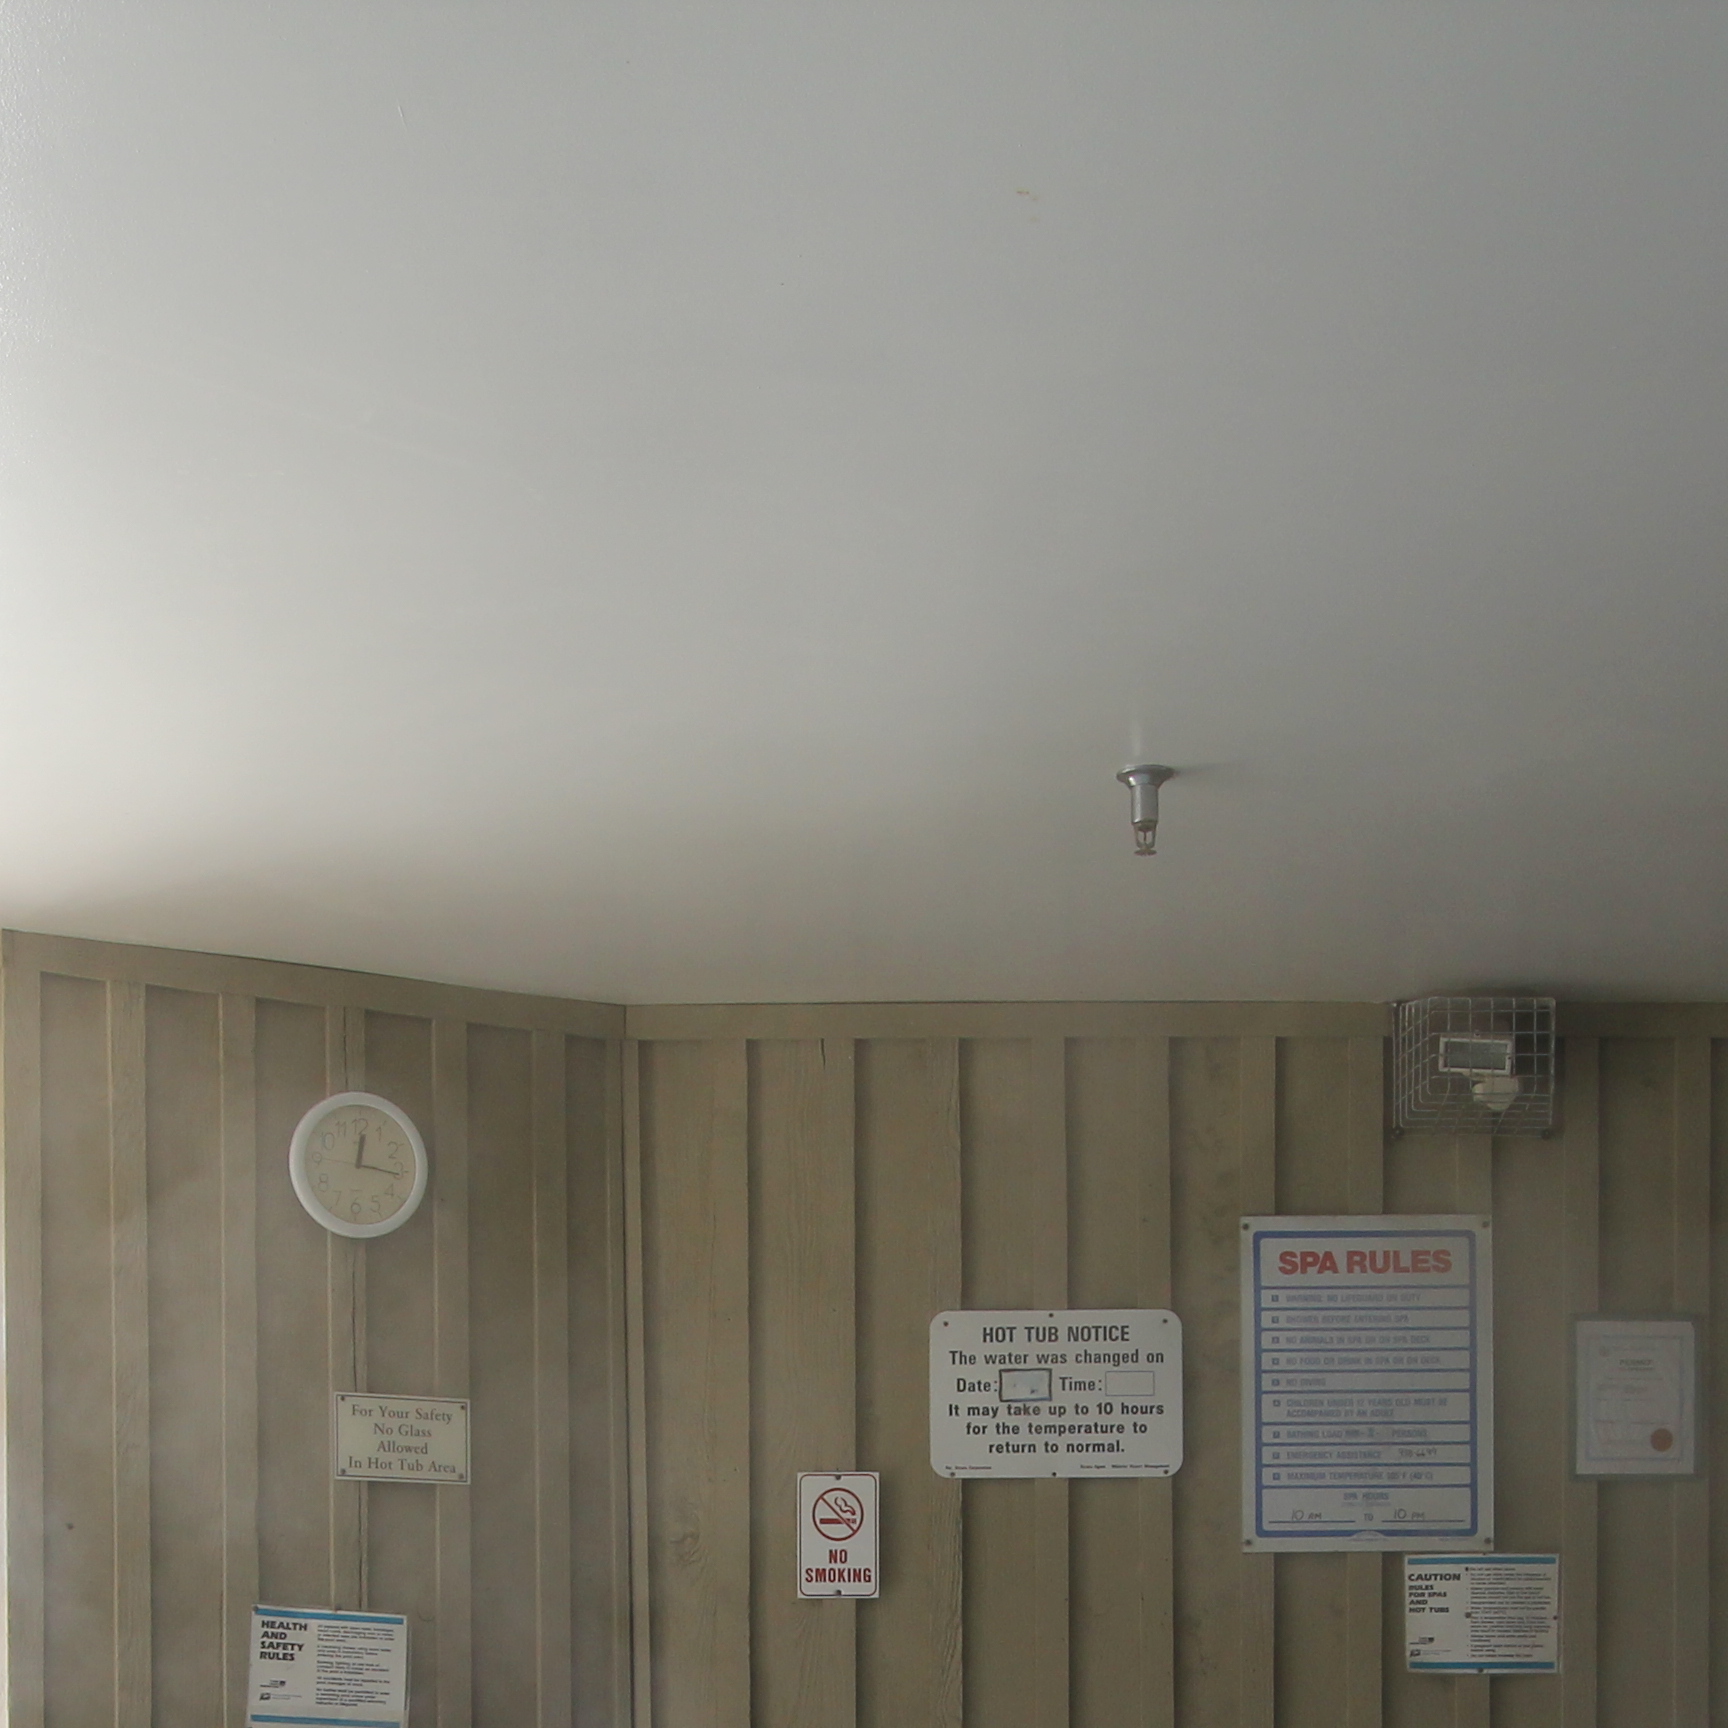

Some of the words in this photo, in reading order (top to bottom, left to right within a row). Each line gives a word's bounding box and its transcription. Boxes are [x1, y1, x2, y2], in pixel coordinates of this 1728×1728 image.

[335, 1120, 347, 1138] 11
[352, 1118, 368, 1135] 12
[375, 1126, 382, 1141] 1
[388, 1142, 398, 1159] 2
[312, 1152, 322, 1166] 9
[393, 1162, 404, 1180] 3
[318, 1173, 329, 1192] 8
[333, 1191, 342, 1206] 7
[384, 1184, 394, 1198] 4
[350, 1197, 362, 1214] 6
[370, 1195, 381, 1213] 5
[1278, 1250, 1340, 1275] SPA
[1346, 1250, 1453, 1275] RULES
[982, 1326, 1016, 1343] HOT
[1024, 1326, 1059, 1342] TUB
[1068, 1325, 1130, 1342] NOTICE
[950, 1351, 976, 1365] The
[984, 1352, 1028, 1365] water
[1036, 1352, 1067, 1364] was
[1075, 1350, 1139, 1367] changed
[1146, 1352, 1164, 1364] on
[956, 1378, 998, 1393] Date:
[1060, 1376, 1102, 1392] Time:
[352, 1404, 374, 1417] For
[378, 1405, 410, 1419] Your
[415, 1408, 453, 1425] Safety
[948, 1404, 960, 1416] It
[967, 1406, 999, 1418] may
[1006, 1403, 1040, 1416] take
[1048, 1405, 1066, 1418] up
[1074, 1404, 1088, 1416] to
[1096, 1403, 1114, 1415] 10
[1120, 1402, 1164, 1415] hours
[374, 1422, 394, 1436] No
[398, 1424, 432, 1438] Glass
[966, 1422, 988, 1435] for
[996, 1422, 1020, 1435] the
[1028, 1422, 1125, 1436] temperature
[1132, 1422, 1148, 1434] to
[377, 1440, 428, 1455] Allowed
[989, 1442, 1036, 1454] return
[1044, 1441, 1058, 1454] to
[1066, 1440, 1124, 1453] normal.
[348, 1456, 362, 1468] In
[368, 1456, 392, 1470] Hot
[398, 1458, 424, 1472] Tub
[428, 1460, 456, 1474] Area
[1292, 1510, 1304, 1520] 10
[1394, 1508, 1406, 1519] 10
[828, 1549, 848, 1564] NO
[805, 1568, 872, 1582] SMOKING
[1408, 1573, 1461, 1581] CAUTION
[261, 1620, 308, 1632] HEALTH
[261, 1631, 288, 1640] AND
[260, 1641, 304, 1652] SAFETY
[260, 1652, 295, 1661] RULES
